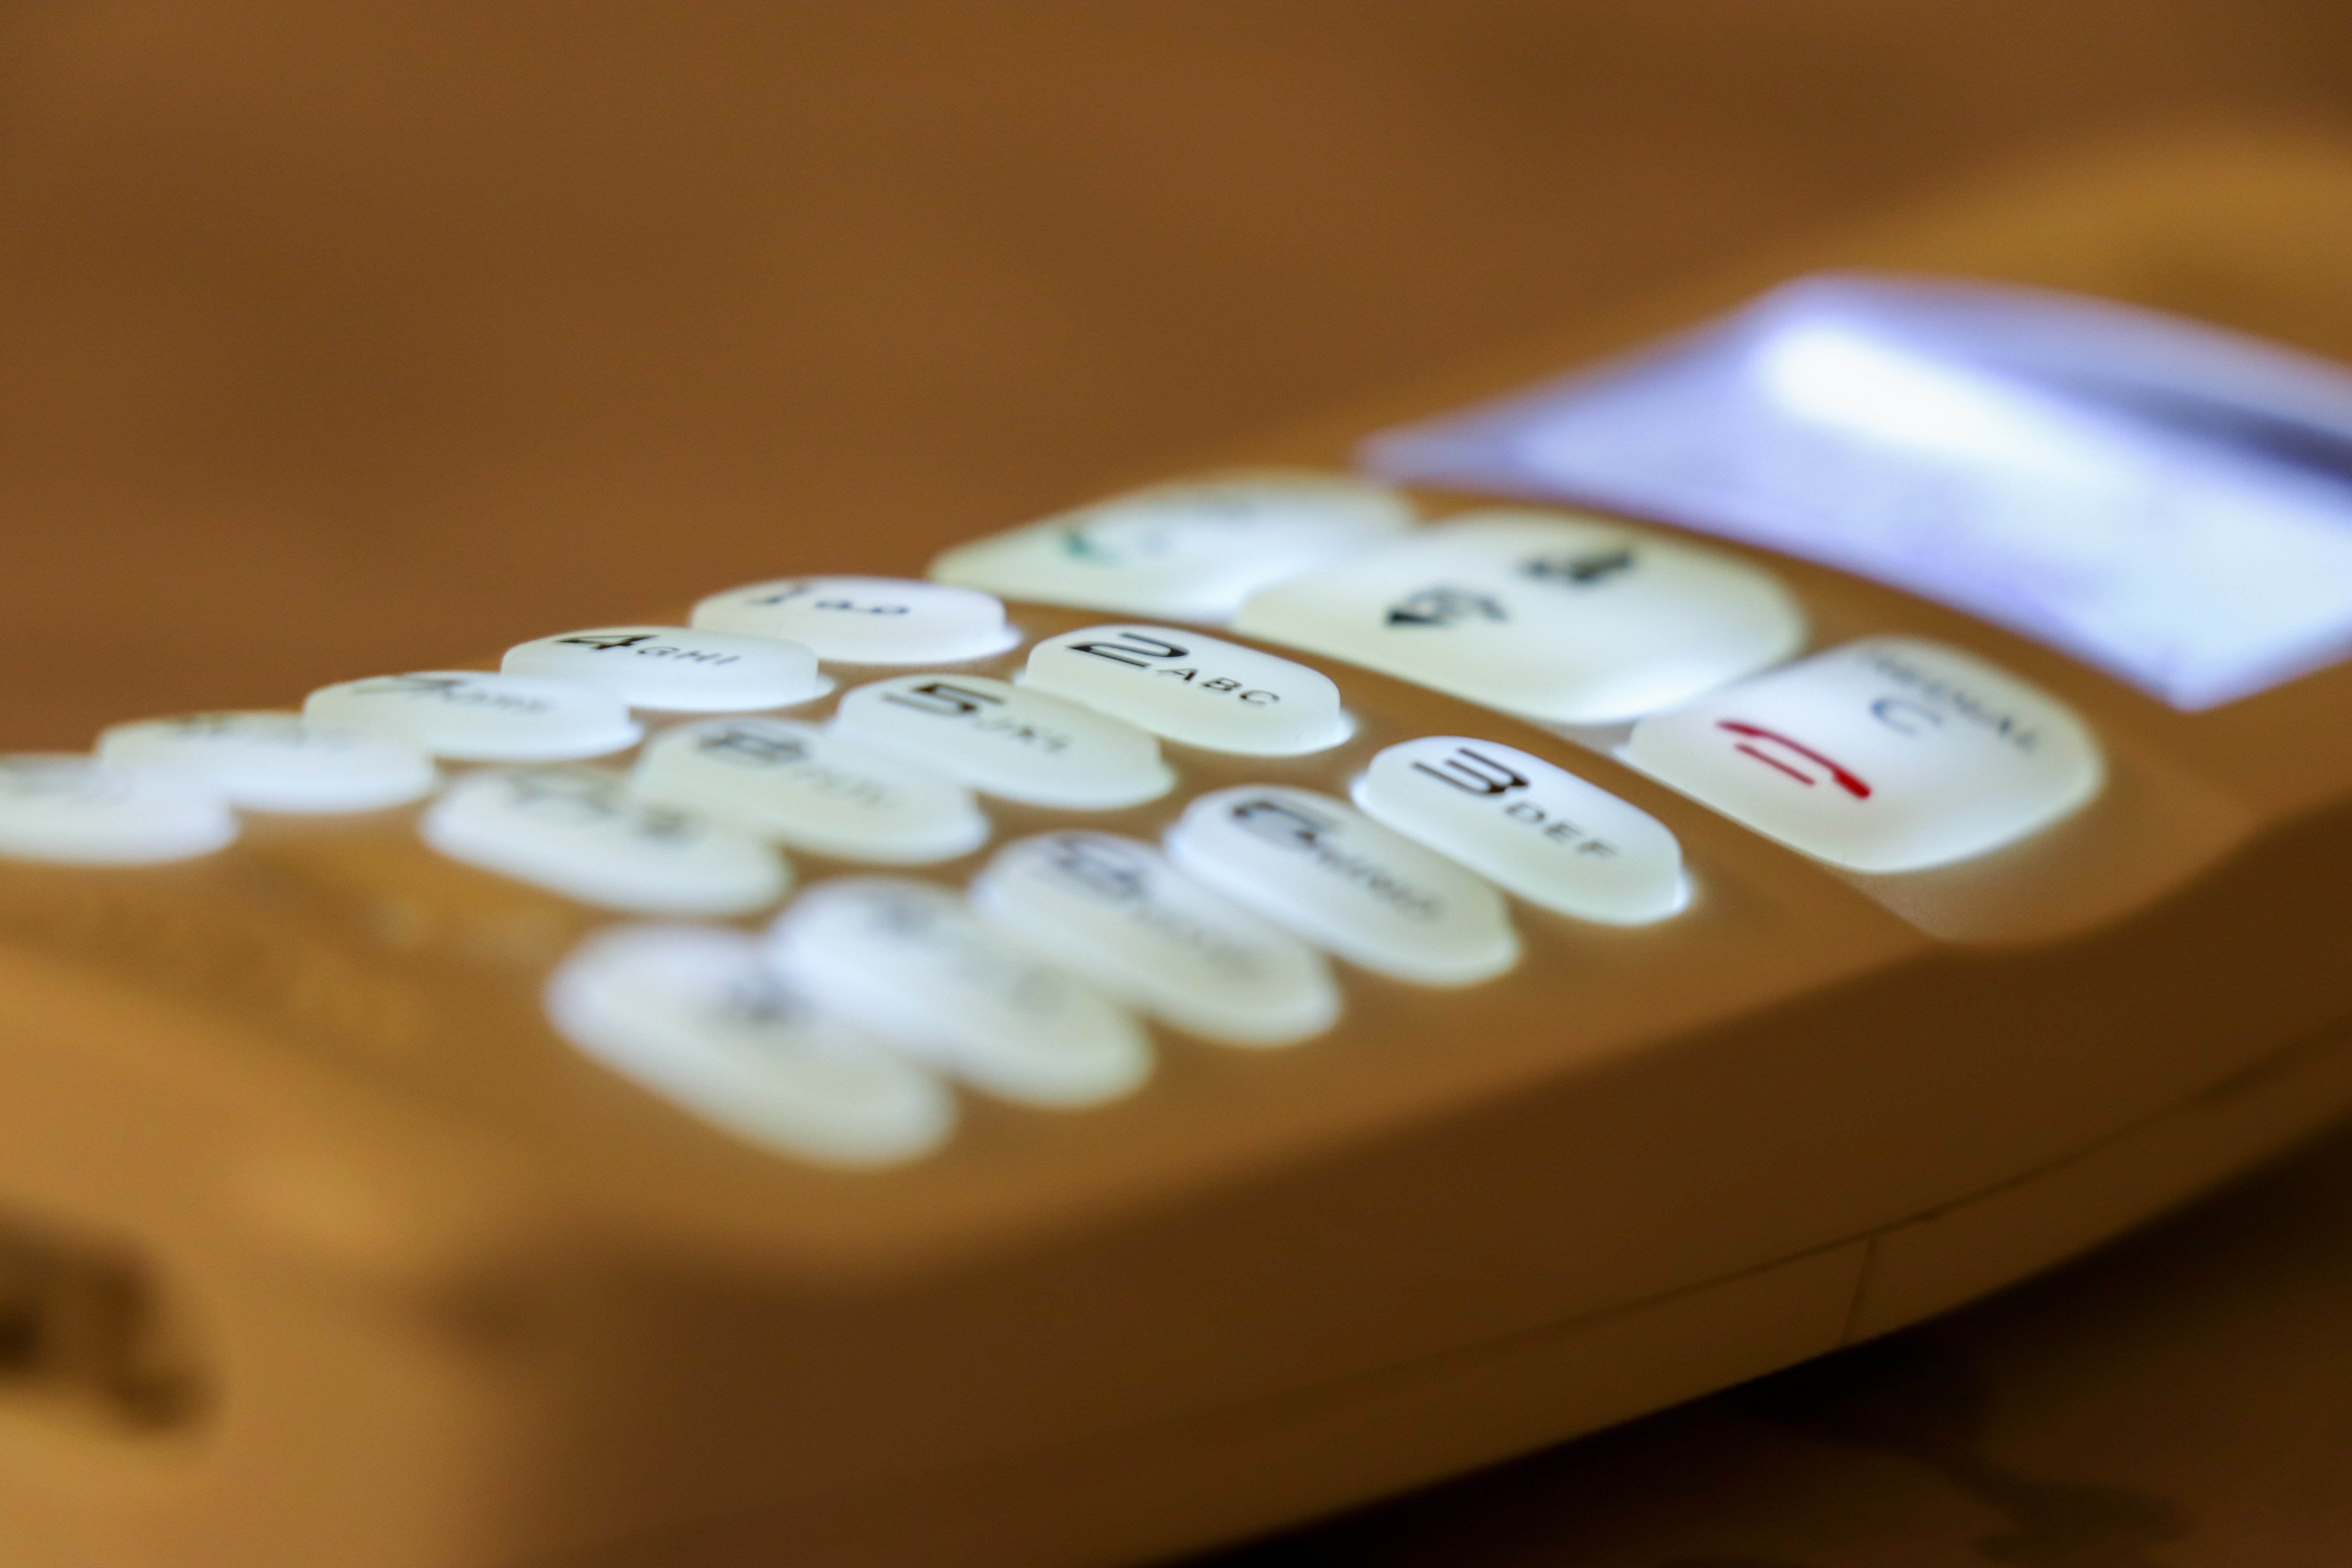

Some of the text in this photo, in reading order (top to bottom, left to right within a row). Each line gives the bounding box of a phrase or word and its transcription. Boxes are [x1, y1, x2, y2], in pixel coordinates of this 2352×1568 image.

[554, 634, 741, 665] 4 GHI
[1066, 633, 1281, 705] 2 ABC
[881, 683, 1006, 717] 5
[1869, 696, 1943, 737] C
[1411, 748, 1618, 858] 3 DEF
